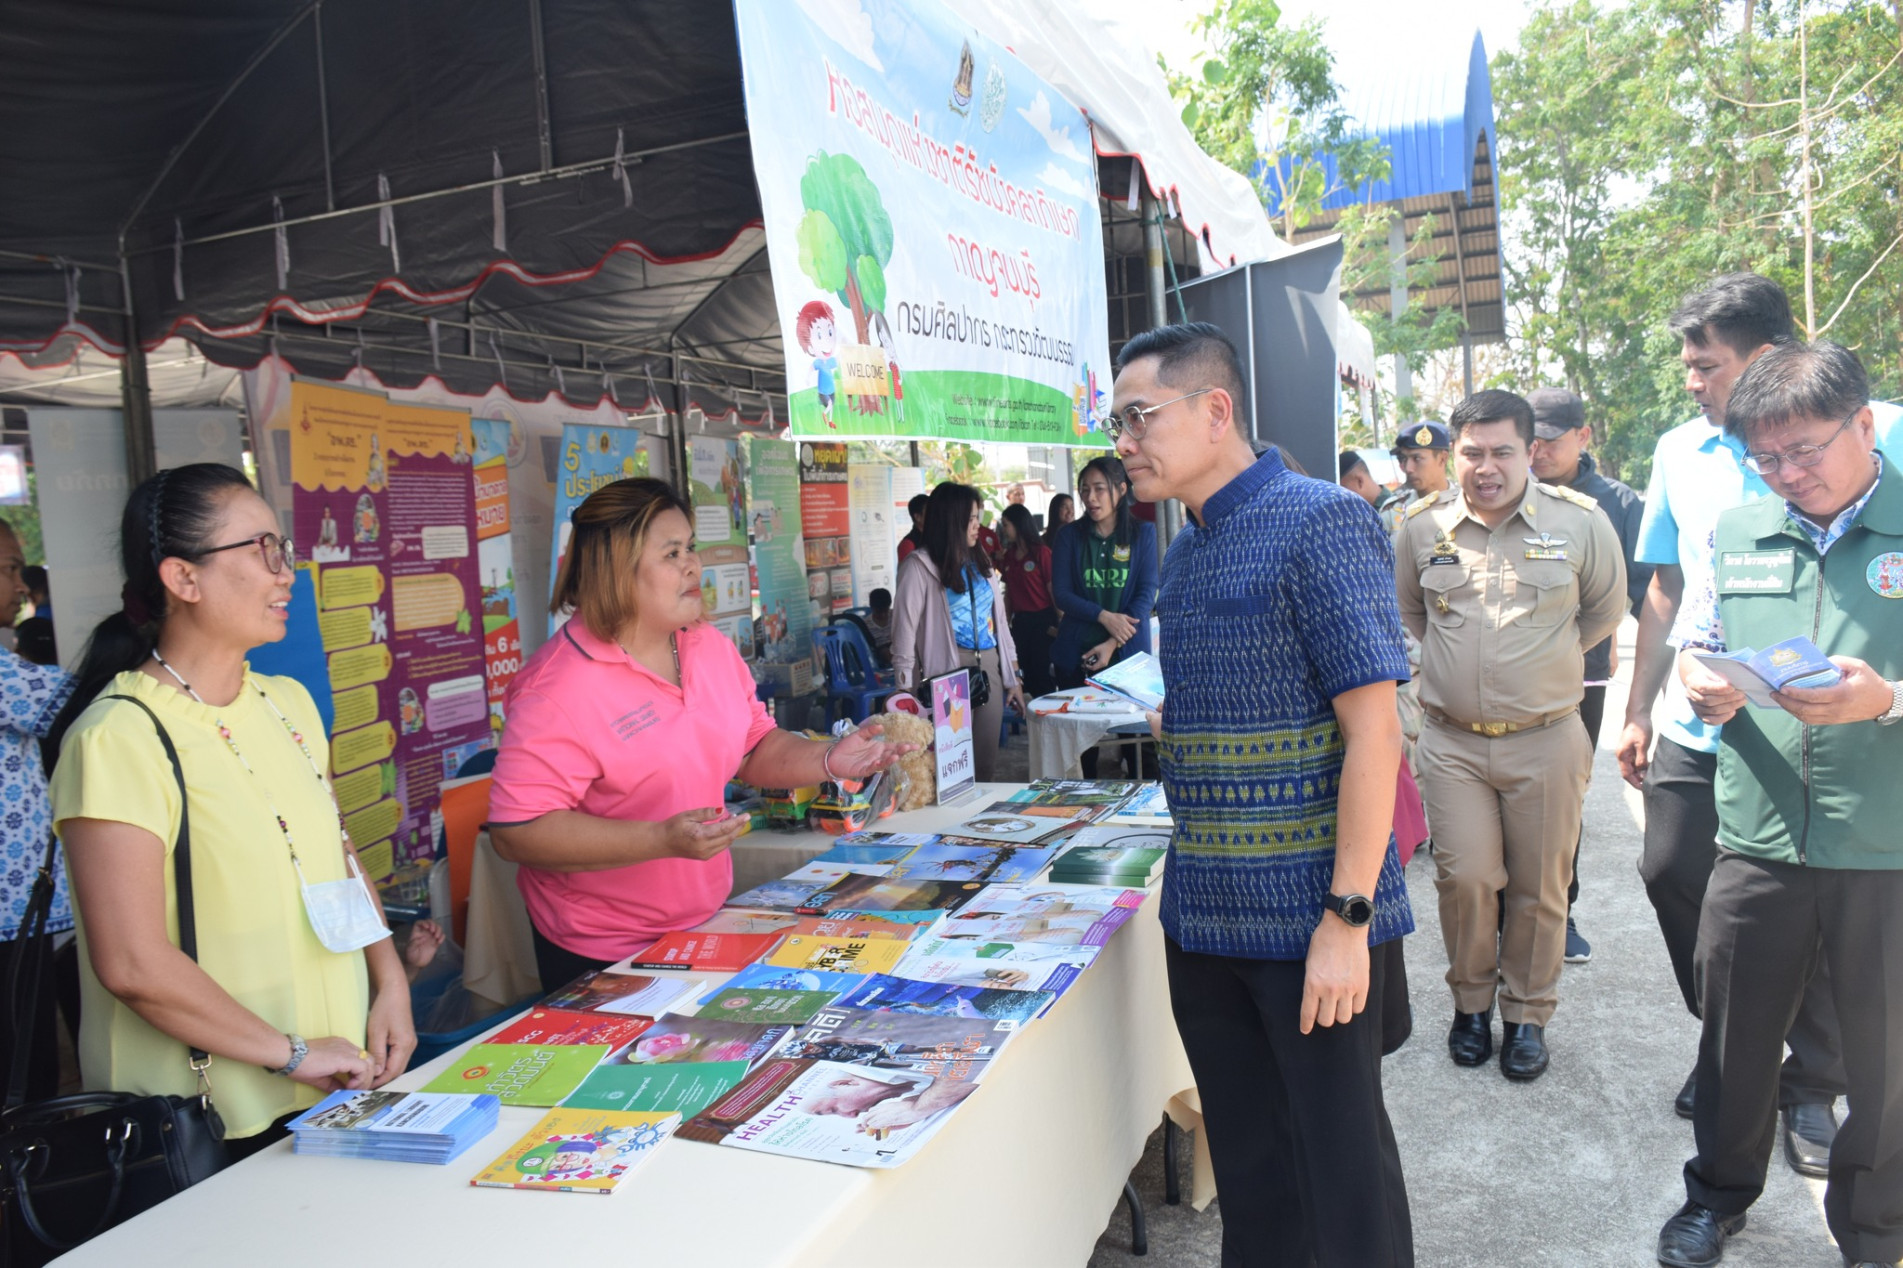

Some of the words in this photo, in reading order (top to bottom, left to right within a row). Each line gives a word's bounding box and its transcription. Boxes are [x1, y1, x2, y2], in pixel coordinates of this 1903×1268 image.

[947, 232, 1041, 312] กาญจนบุรี
[897, 300, 991, 347] กรมศิลปากร
[846, 362, 885, 380] WELCOME
[564, 441, 581, 472] 5
[941, 748, 969, 779] แจกฟรี
[736, 1094, 804, 1141] HEALTH
